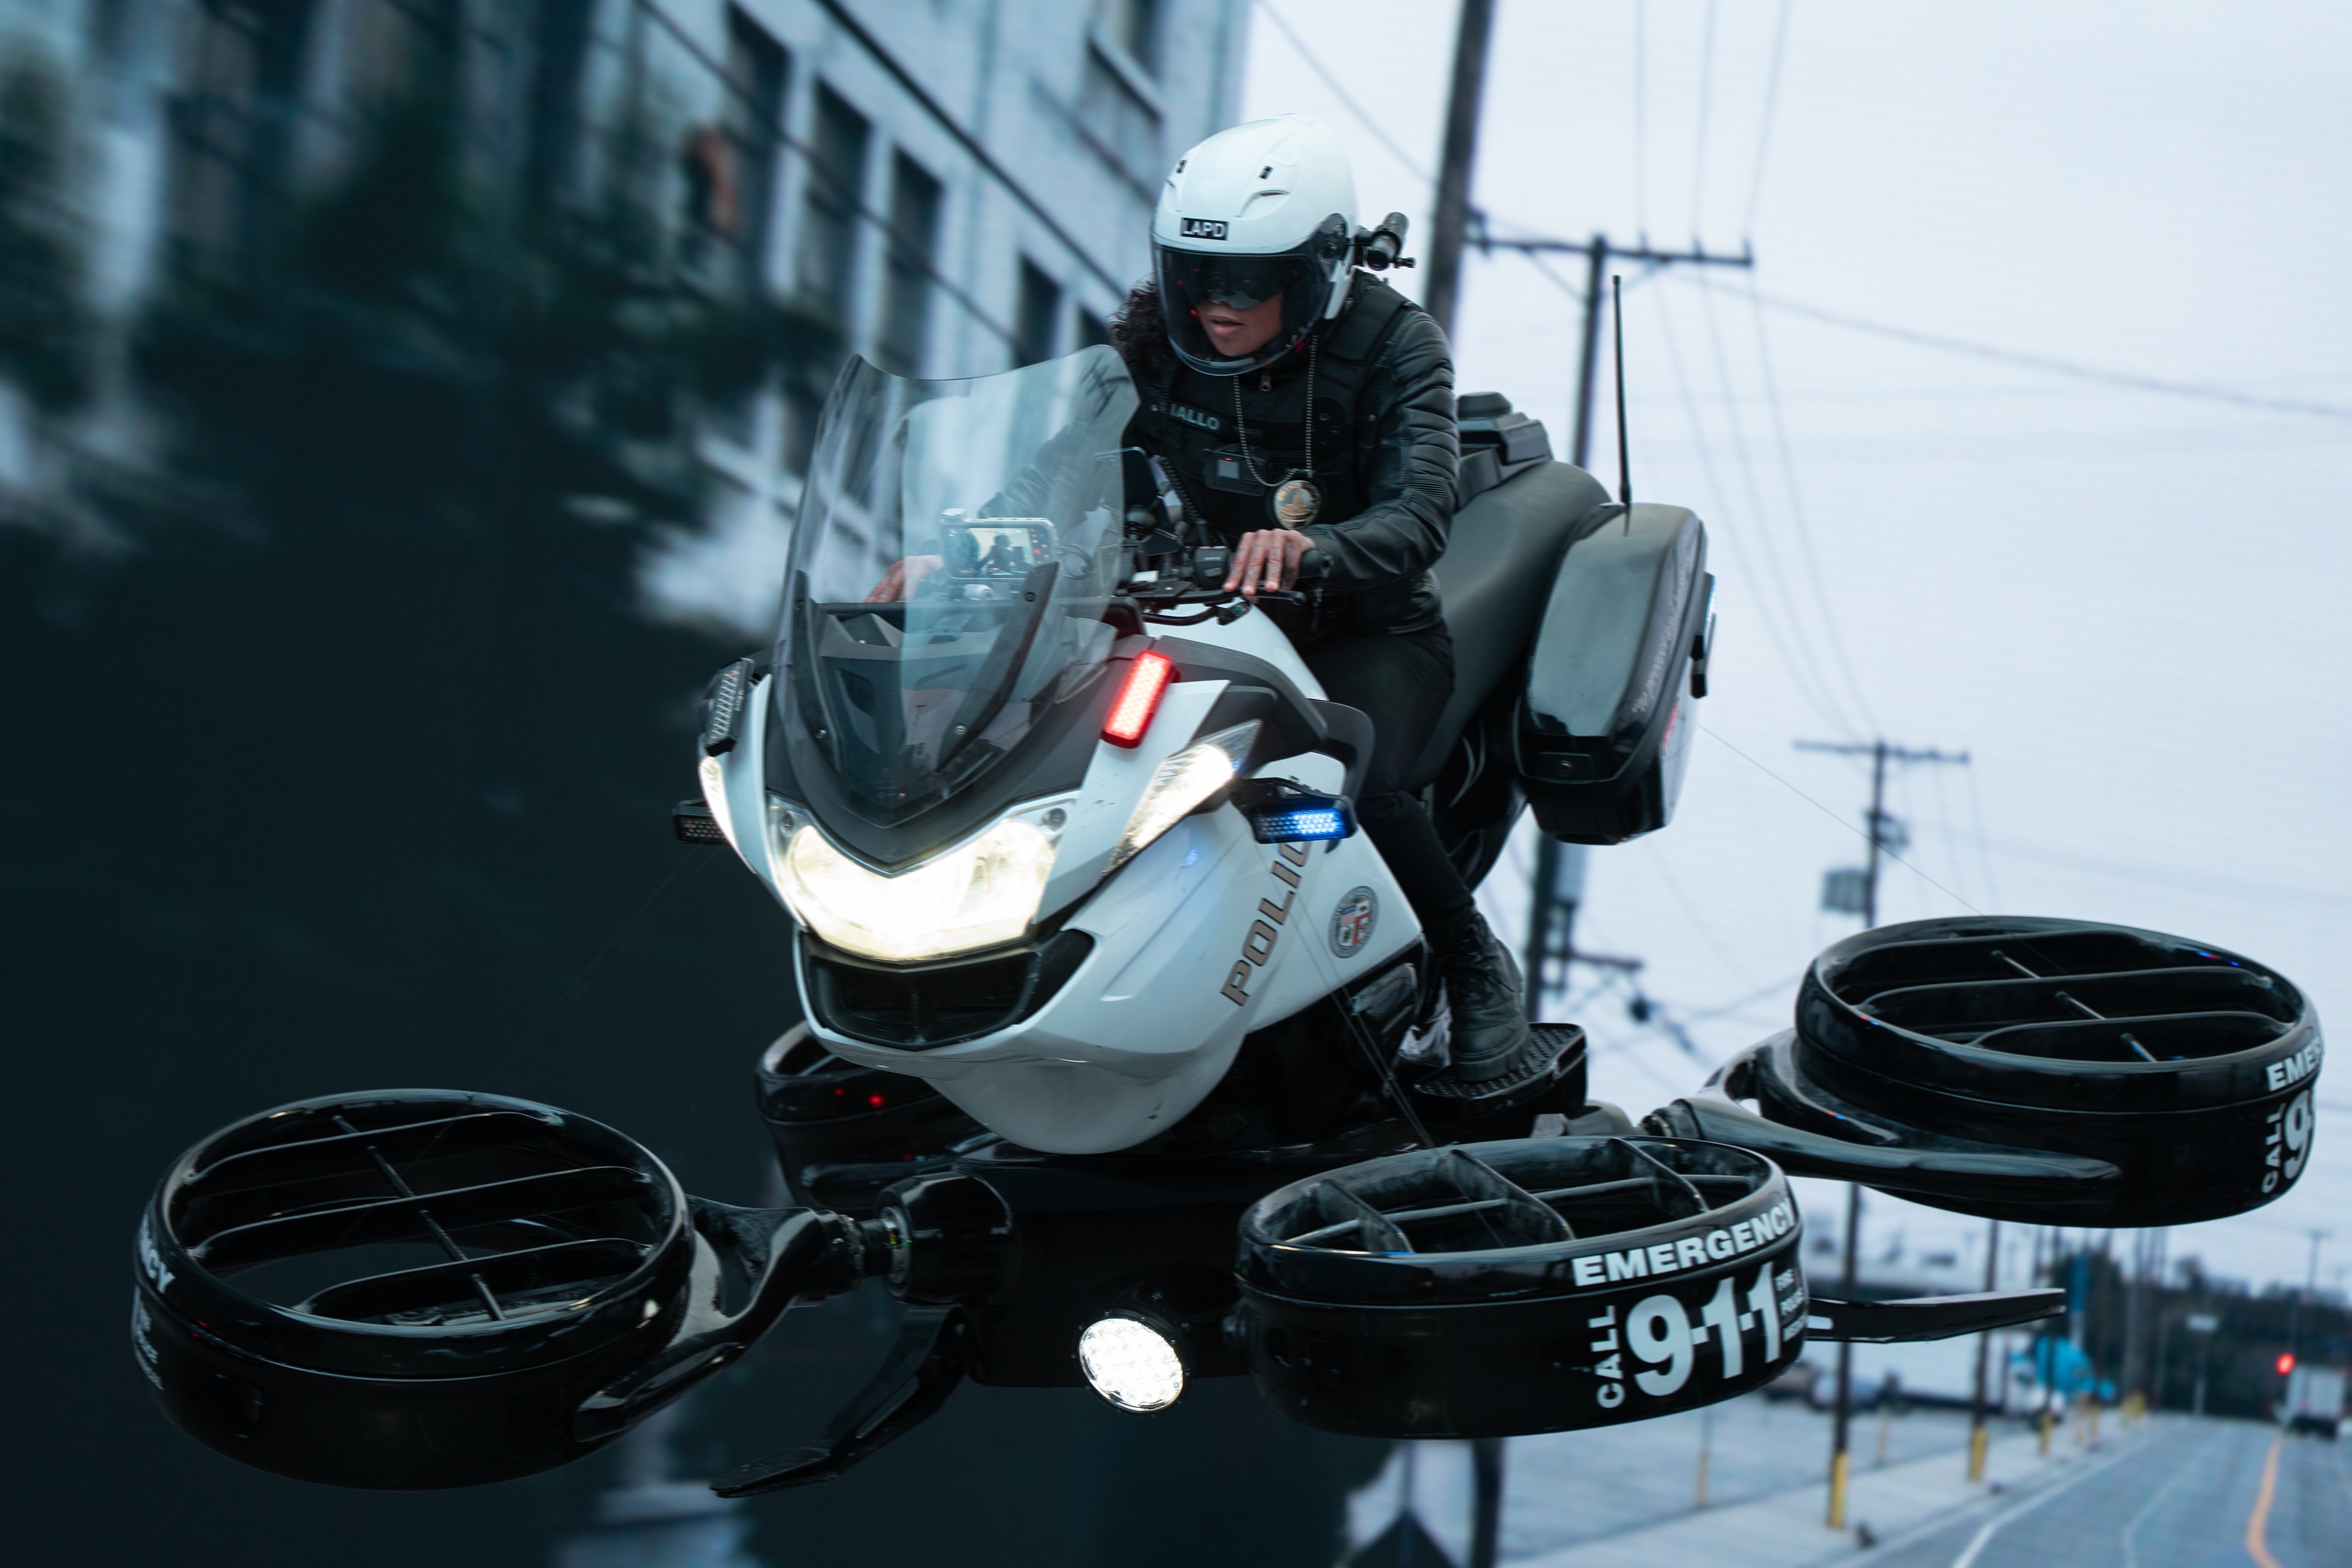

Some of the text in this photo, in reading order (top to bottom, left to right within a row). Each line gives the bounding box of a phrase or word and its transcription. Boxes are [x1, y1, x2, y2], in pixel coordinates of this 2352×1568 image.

[1180, 219, 1227, 238] LAPD
[2261, 1102, 2287, 1194] CALL
[1572, 1197, 1795, 1287] EMERGENCY
[1587, 1305, 1627, 1409] CALL
[1625, 1261, 1781, 1397] 9-1-1
